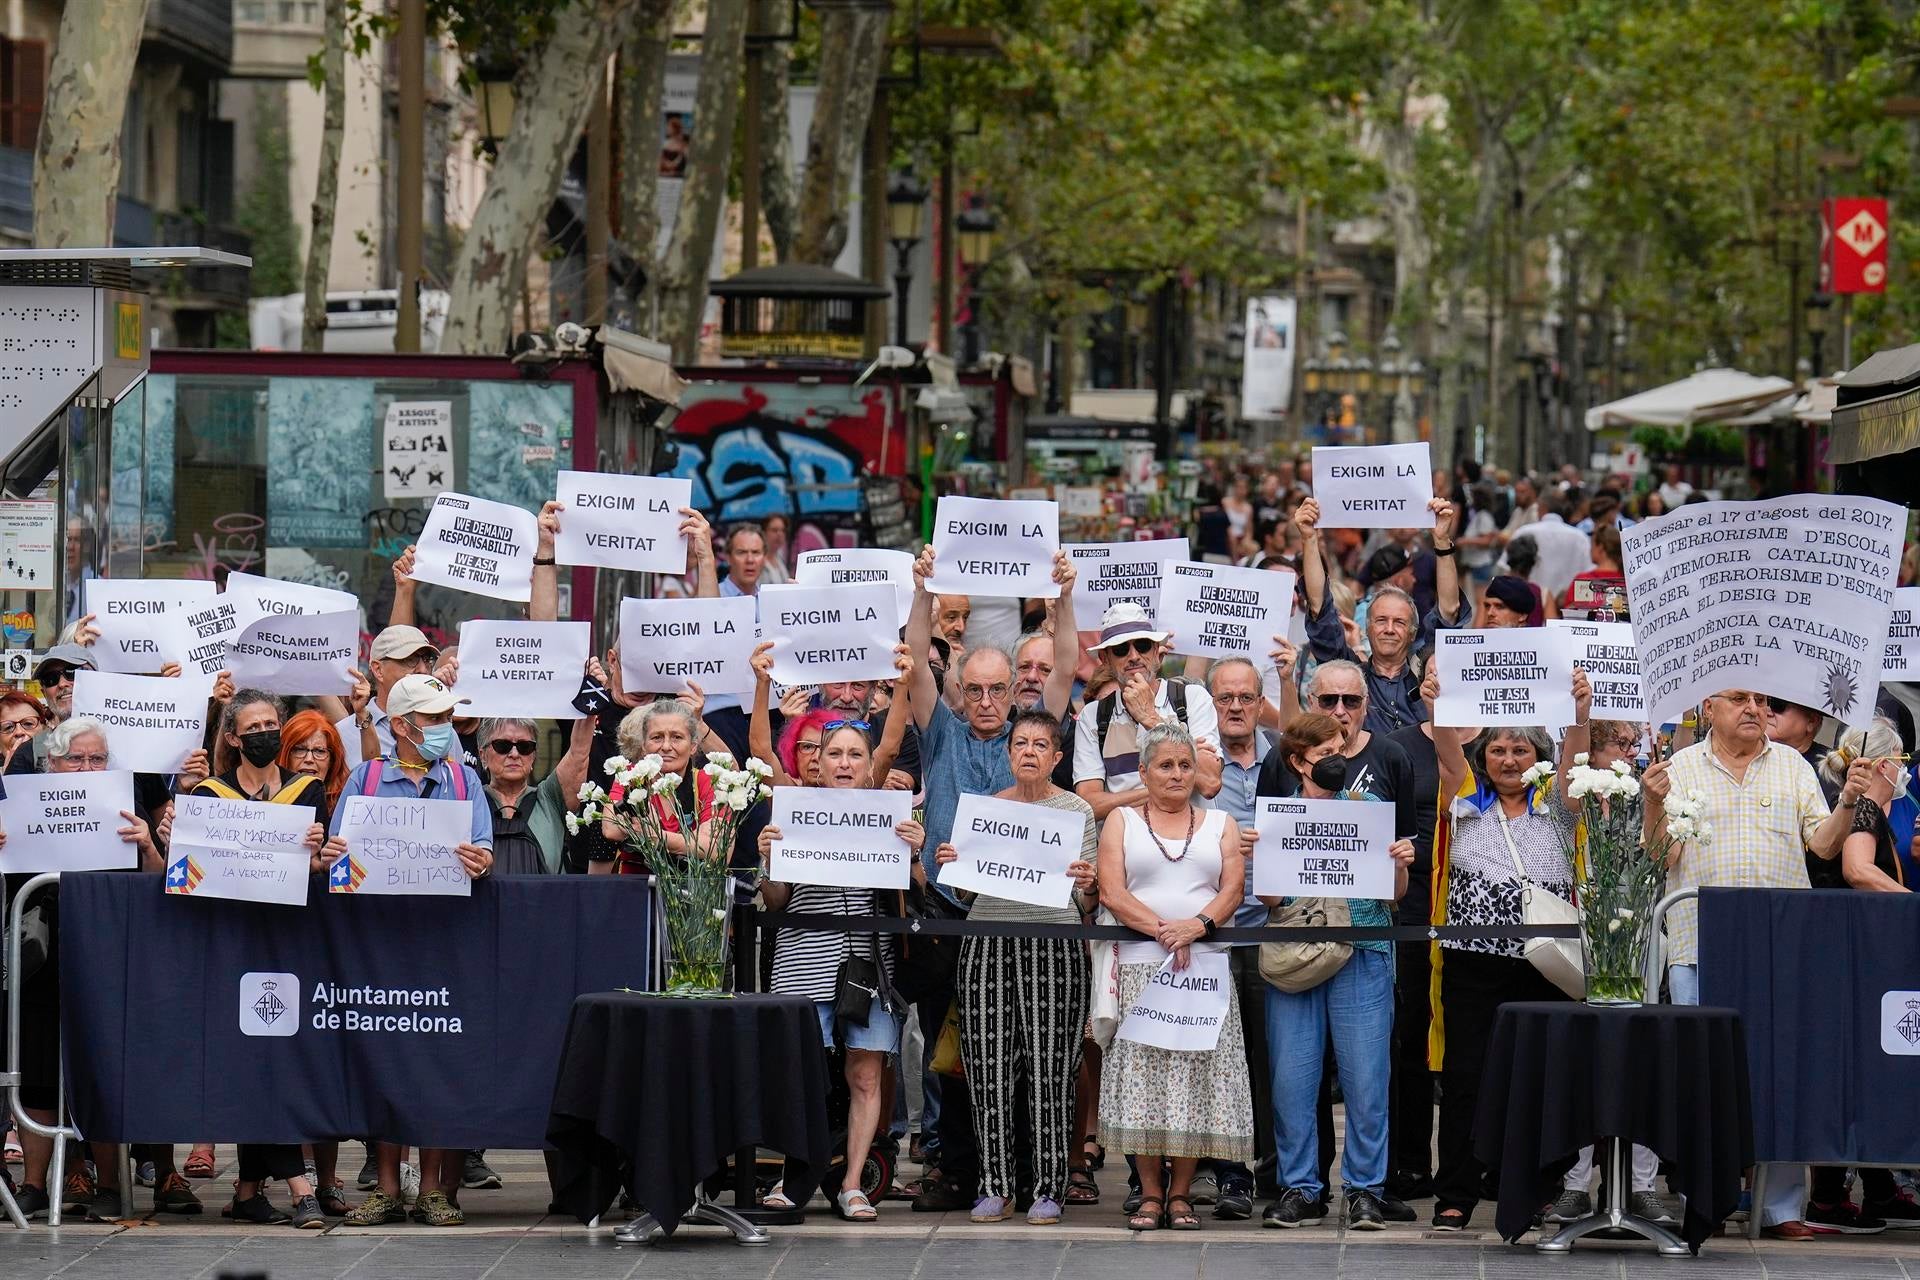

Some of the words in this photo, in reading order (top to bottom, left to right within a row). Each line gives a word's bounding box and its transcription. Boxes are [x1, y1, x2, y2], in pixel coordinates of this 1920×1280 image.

[1854, 223, 1873, 242] M
[398, 409, 437, 417] BASQUE
[1331, 466, 1385, 478] EXIGIM
[1397, 464, 1416, 477] LA
[576, 493, 635, 511] EXIGIM
[648, 497, 670, 513] LA
[1342, 499, 1406, 511] VERITAT
[456, 517, 471, 532] WE
[472, 520, 511, 540] DEMAND
[948, 520, 1008, 537] EXIGIM
[1021, 524, 1044, 538] LA
[1624, 537, 1641, 552] Va
[1643, 517, 1693, 548] passar
[1698, 513, 1713, 527] el
[1720, 511, 1741, 523] 17
[1745, 506, 1810, 521] d'agost
[1818, 506, 1846, 521] del
[1851, 508, 1893, 532] 2017.
[439, 529, 520, 557] RESPONSABILITY
[585, 533, 656, 552] VERITAT
[806, 555, 814, 563] 17
[815, 554, 840, 563] D'AGOST
[1082, 549, 1109, 557] D'AGOST
[1629, 545, 1662, 575] ¿FOU
[1667, 527, 1788, 555] TERRORISME
[1804, 530, 1891, 560] D'ESCOLA
[457, 553, 474, 566] WE
[474, 556, 496, 571] ASK
[957, 559, 1030, 577] VERITAT
[1101, 564, 1116, 577] WE
[1118, 563, 1157, 576] DEMAND
[448, 564, 466, 579] THE
[468, 569, 500, 586] TRUTH
[832, 571, 847, 582] WE
[848, 570, 888, 582] DEMAND
[1177, 566, 1185, 575] 17
[1185, 567, 1212, 578] D'AGOST
[1632, 577, 1658, 602] PER
[1662, 549, 1751, 585] ATEMORIR
[1768, 548, 1890, 581] CATALUNYA?
[1088, 576, 1162, 592] RESPONSABILIT
[1202, 586, 1217, 600] WE
[1218, 588, 1257, 604] DEMAND
[1637, 599, 1656, 626] ¿VA
[1659, 584, 1690, 608] SER
[1699, 567, 1823, 591] TERRORISME
[1825, 572, 1893, 605] D'ESTAT
[107, 601, 165, 614] EXIGIM
[218, 603, 236, 618] THE
[1186, 599, 1267, 620] RESPONSABILITY
[187, 609, 218, 627] TRUTH
[781, 609, 841, 626] EXIGIM
[855, 606, 877, 622] LA
[1639, 607, 1691, 645] CONTRA
[1696, 594, 1715, 613] EL
[1719, 587, 1776, 604] DESIG
[1784, 590, 1812, 606] DE
[199, 622, 218, 638] ASK
[641, 622, 700, 637] EXIGIM
[714, 620, 735, 634] LA
[1207, 622, 1223, 635] WE
[1224, 623, 1246, 637] ASK
[1768, 615, 1869, 652] CATALANS?
[257, 631, 329, 647] RECLAMEM
[495, 637, 542, 648] EXIGIM
[1198, 634, 1217, 647] THE
[1219, 636, 1250, 651] TRUTH
[1455, 636, 1482, 644] D'AGOST
[233, 641, 352, 661] RESPONSABILITATS
[500, 653, 540, 664] SABER
[795, 647, 868, 664] VERITAT
[1475, 653, 1491, 665] WE
[1494, 652, 1535, 665] DEMAND
[1588, 645, 1604, 658] WE
[1692, 634, 1745, 663] SABER
[1755, 634, 1782, 650] LA
[1792, 639, 1862, 675] VERITAT
[482, 669, 498, 679] LA
[502, 670, 554, 681] VERITAT
[653, 660, 725, 676] VERITAT
[1461, 667, 1548, 681] RESPONSABILITY
[1657, 677, 1682, 701] TOT
[1691, 653, 1759, 683] PLEGAT!
[1487, 689, 1503, 700] WE
[1506, 688, 1528, 699] ASK
[1596, 682, 1613, 693] WE
[1615, 683, 1637, 694] ASK
[104, 698, 176, 713] RECLAMEM
[1479, 703, 1500, 715] THE
[1502, 702, 1535, 714] TRUTH
[1610, 696, 1643, 709] TRUTH
[39, 789, 87, 801] EXIGIM
[44, 806, 86, 818] SABER
[209, 802, 266, 821] t'oblidem
[349, 801, 426, 829] EXIGIM
[1269, 804, 1277, 812] 17
[1278, 804, 1305, 813] D'AGOST
[791, 811, 893, 828] RECLAMEM
[27, 824, 44, 835] LA
[48, 821, 101, 834] VERITAT
[972, 818, 1029, 841] EXIGIM
[1041, 830, 1062, 846] LA
[1297, 822, 1313, 835] WE
[1316, 823, 1357, 837] DEMAND
[1282, 837, 1369, 852] RESPONSABILITY
[211, 849, 239, 859] VOLEM
[242, 851, 274, 863] SABER
[781, 849, 901, 864] RESPONSABILITATS
[222, 866, 235, 878] LA
[976, 860, 1046, 885] VERITAT
[1306, 859, 1323, 870] WE
[1325, 859, 1347, 871] ASK
[1298, 872, 1318, 884] THE
[1322, 873, 1354, 885] TRUTH
[311, 982, 450, 1008] Ajuntament
[312, 1009, 341, 1030] de
[345, 1010, 463, 1033] Barcelona
